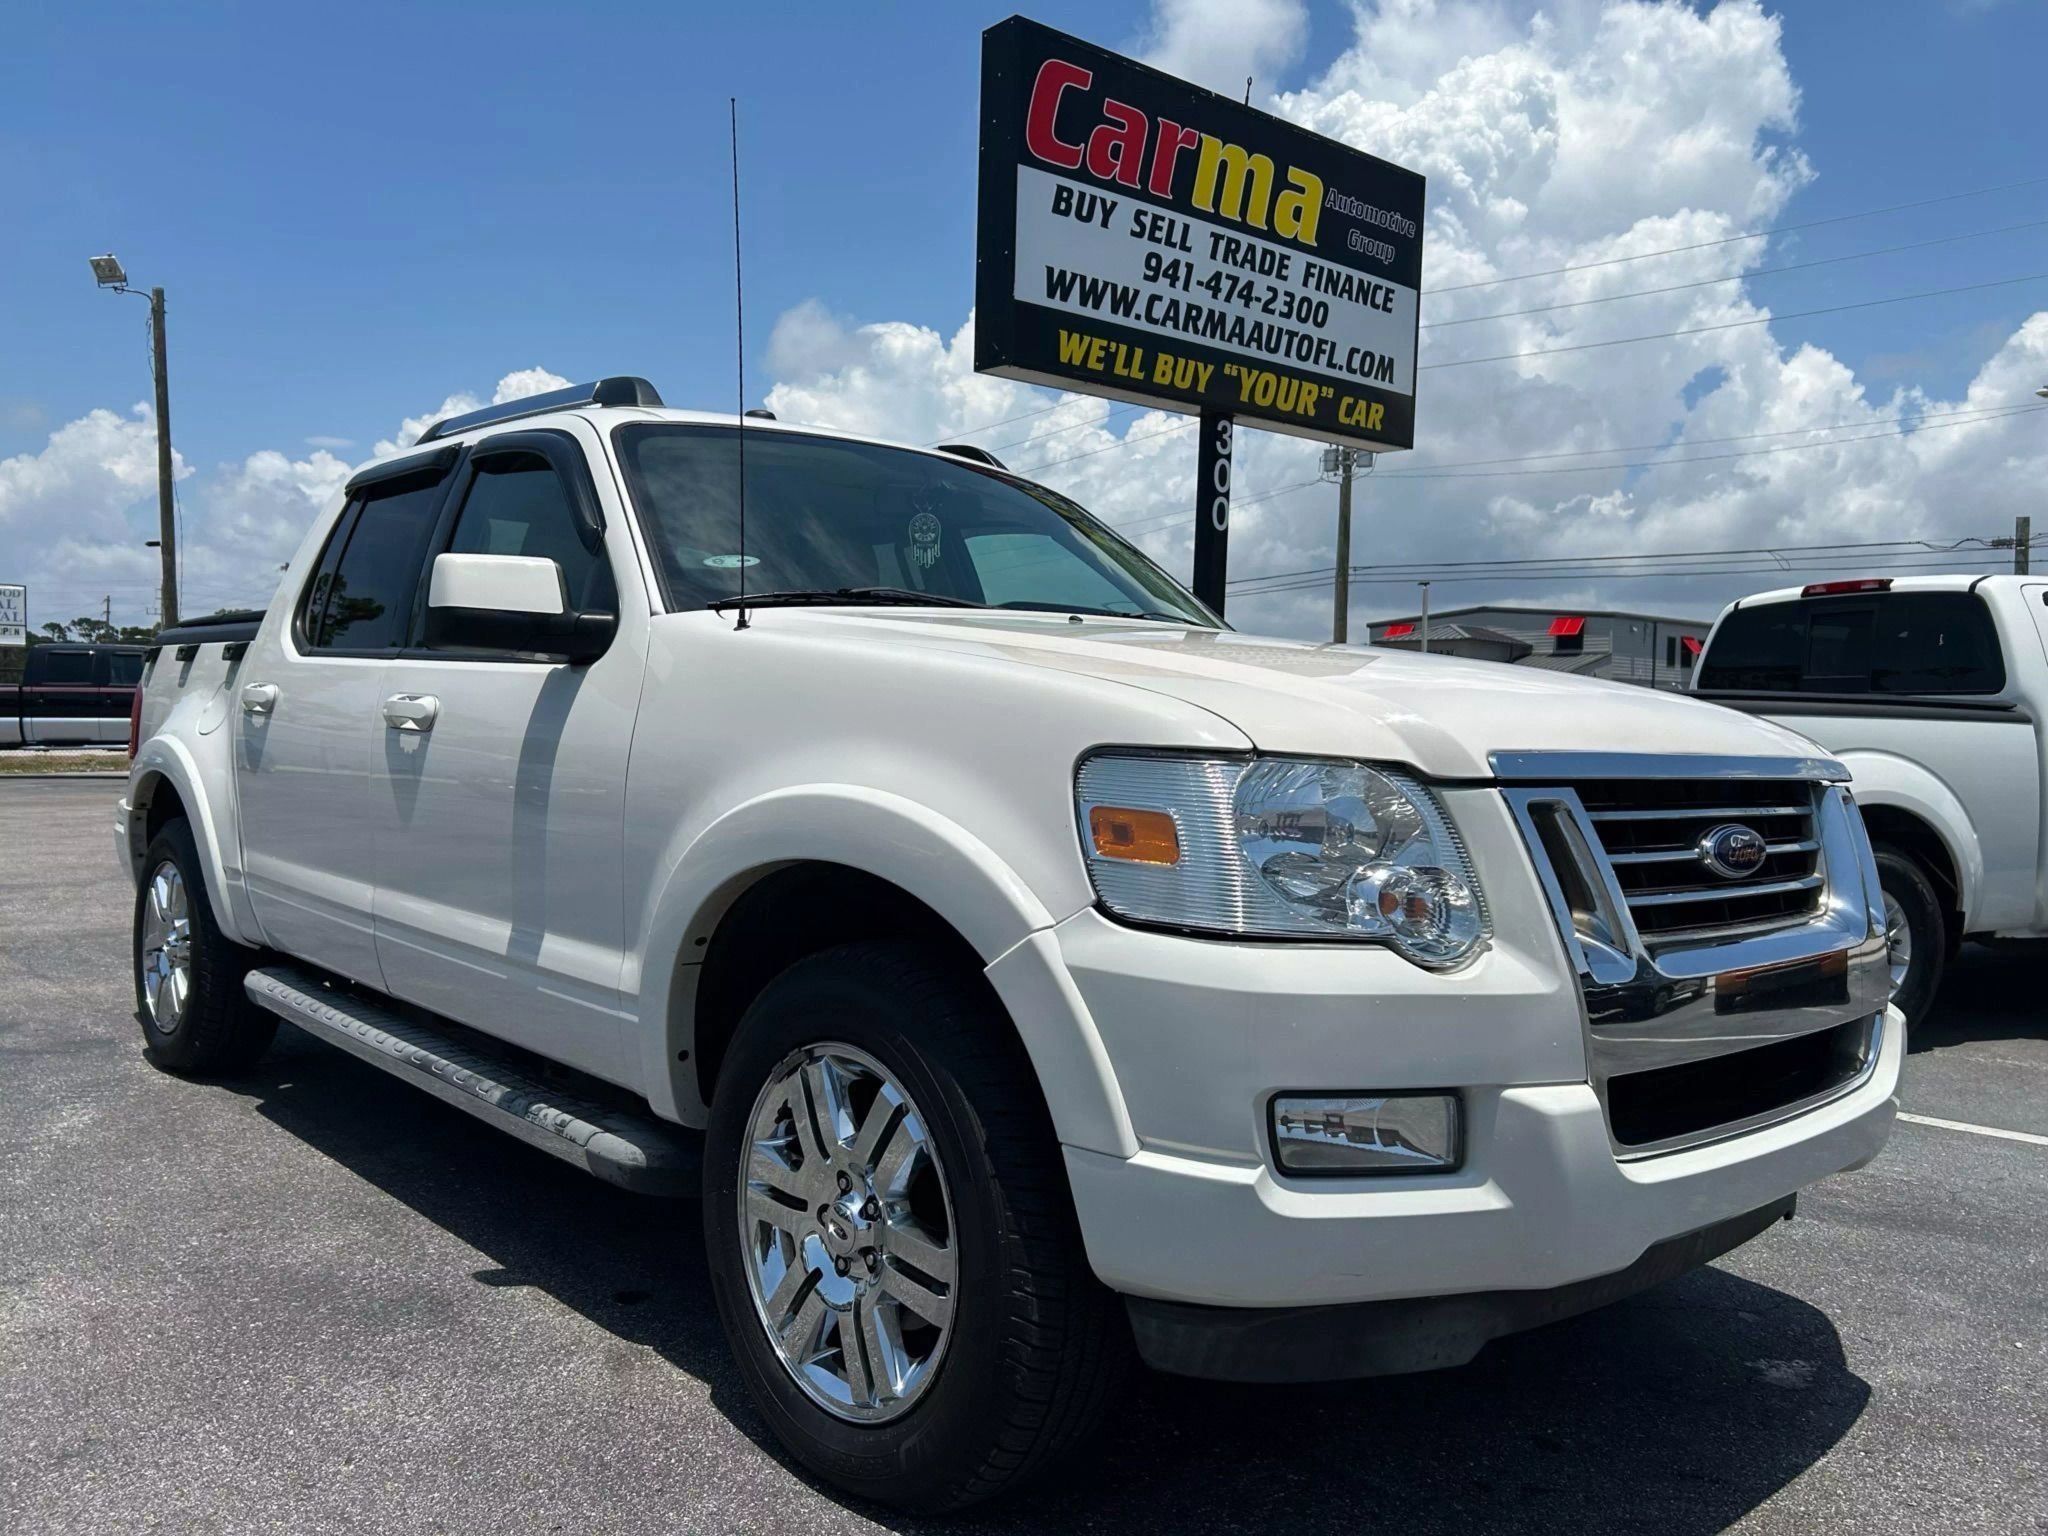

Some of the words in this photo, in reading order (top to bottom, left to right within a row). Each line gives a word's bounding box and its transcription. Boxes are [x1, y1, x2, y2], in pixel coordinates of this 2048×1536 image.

[1026, 58, 1324, 247] Carma
[1051, 183, 1118, 229] BUY
[1130, 208, 1192, 253] SELL
[1209, 231, 1291, 282] TRADE
[1302, 260, 1395, 313] FINANCE
[1325, 188, 1416, 238] Automotive
[1347, 228, 1395, 264] Group
[1045, 265, 1394, 384] WWW.CARMAAUTOFL.COM
[1143, 251, 1329, 328] 941-474-2300
[1059, 329, 1145, 380] WE'LL
[1152, 352, 1214, 393] BUY
[1338, 396, 1384, 431] CAR
[1212, 419, 1232, 531] 300
[0, 589, 20, 598] OD
